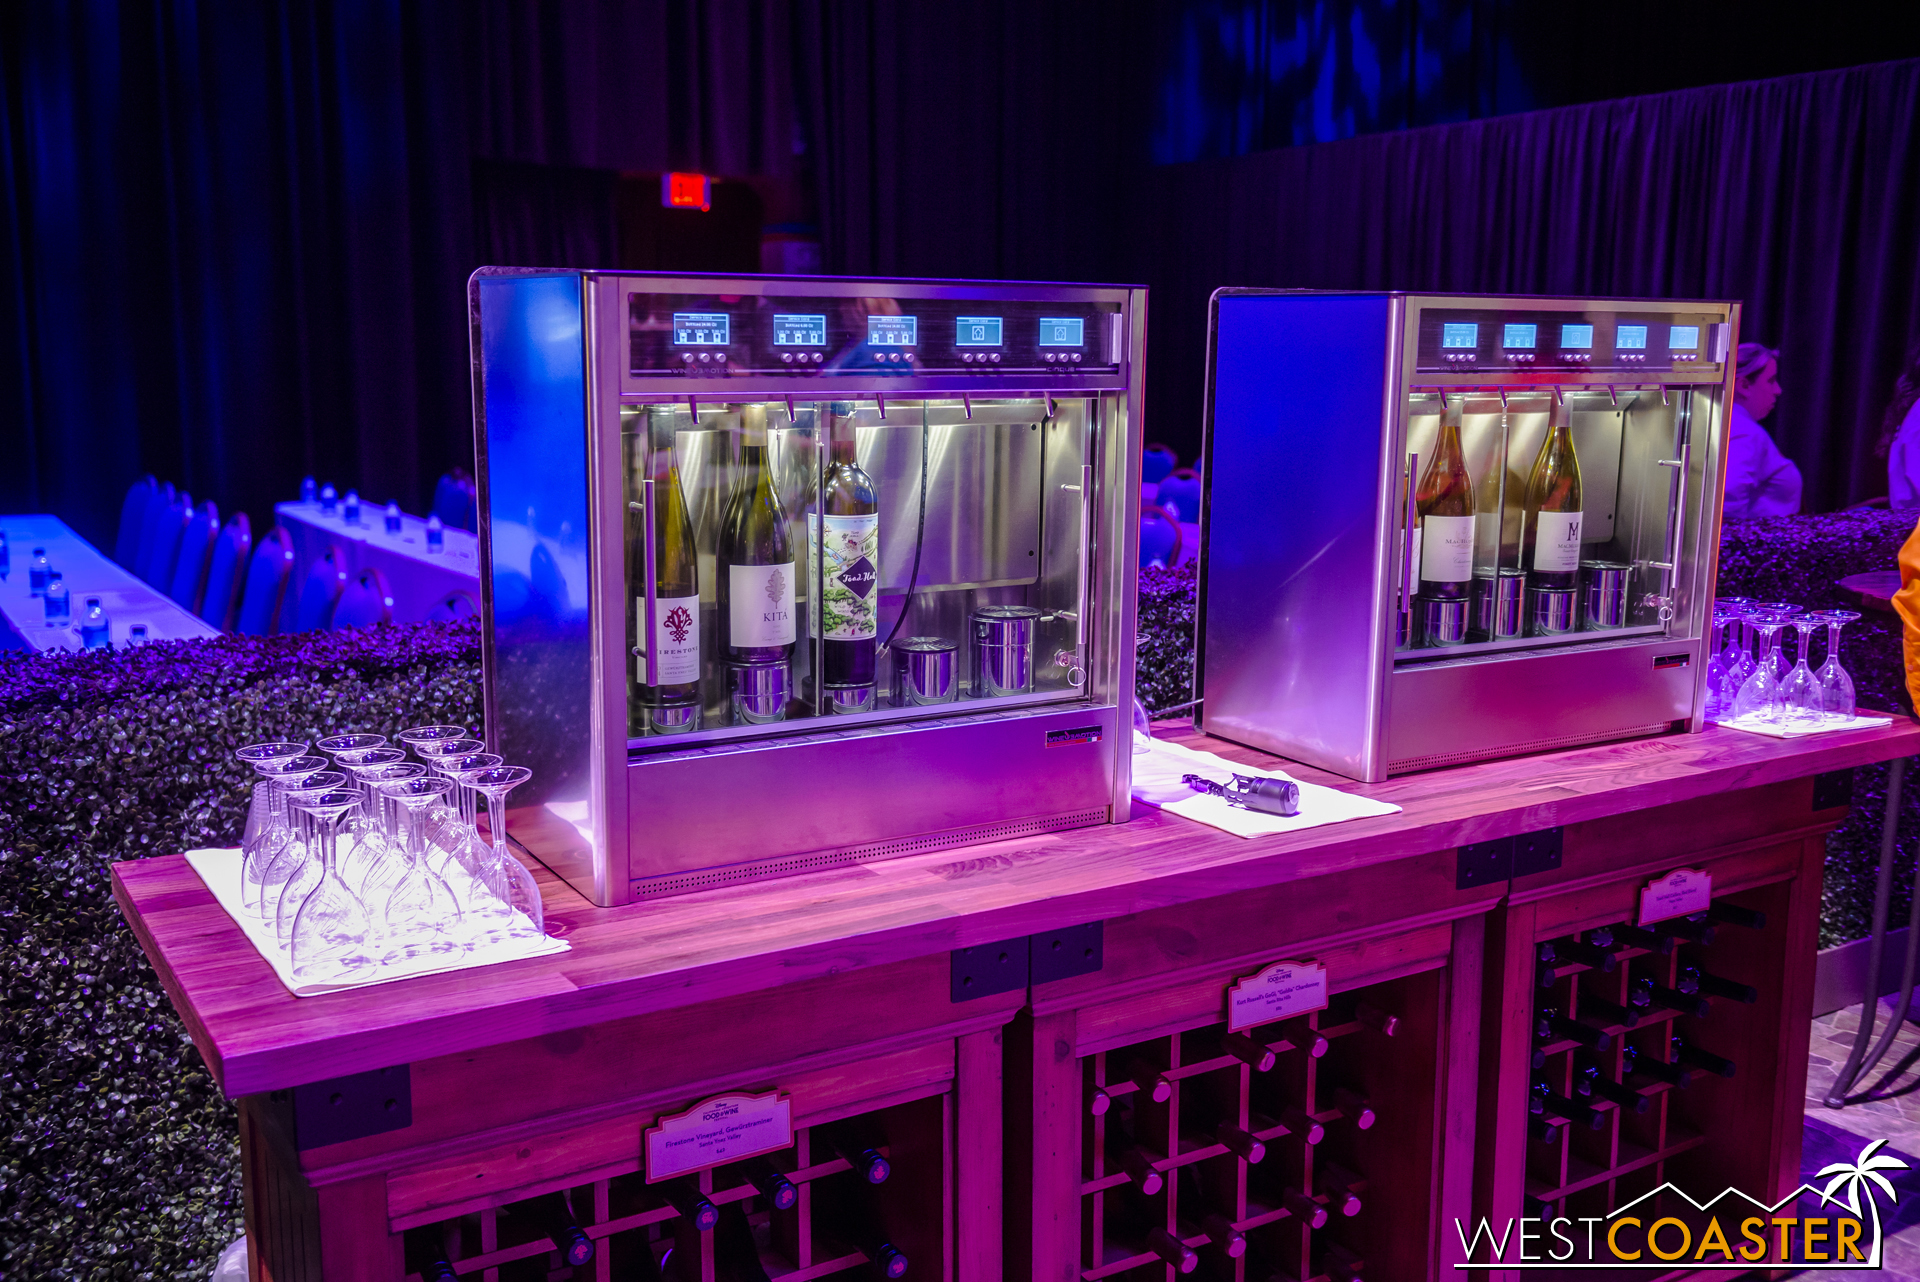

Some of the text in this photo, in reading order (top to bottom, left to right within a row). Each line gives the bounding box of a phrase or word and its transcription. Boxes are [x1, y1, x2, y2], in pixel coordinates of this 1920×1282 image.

[656, 646, 698, 655] IRESTONE
[703, 1112, 720, 1121] FOOD
[724, 1107, 739, 1116] WINE
[666, 1117, 773, 1148] Firestone Vineyard, Gewürztraminer
